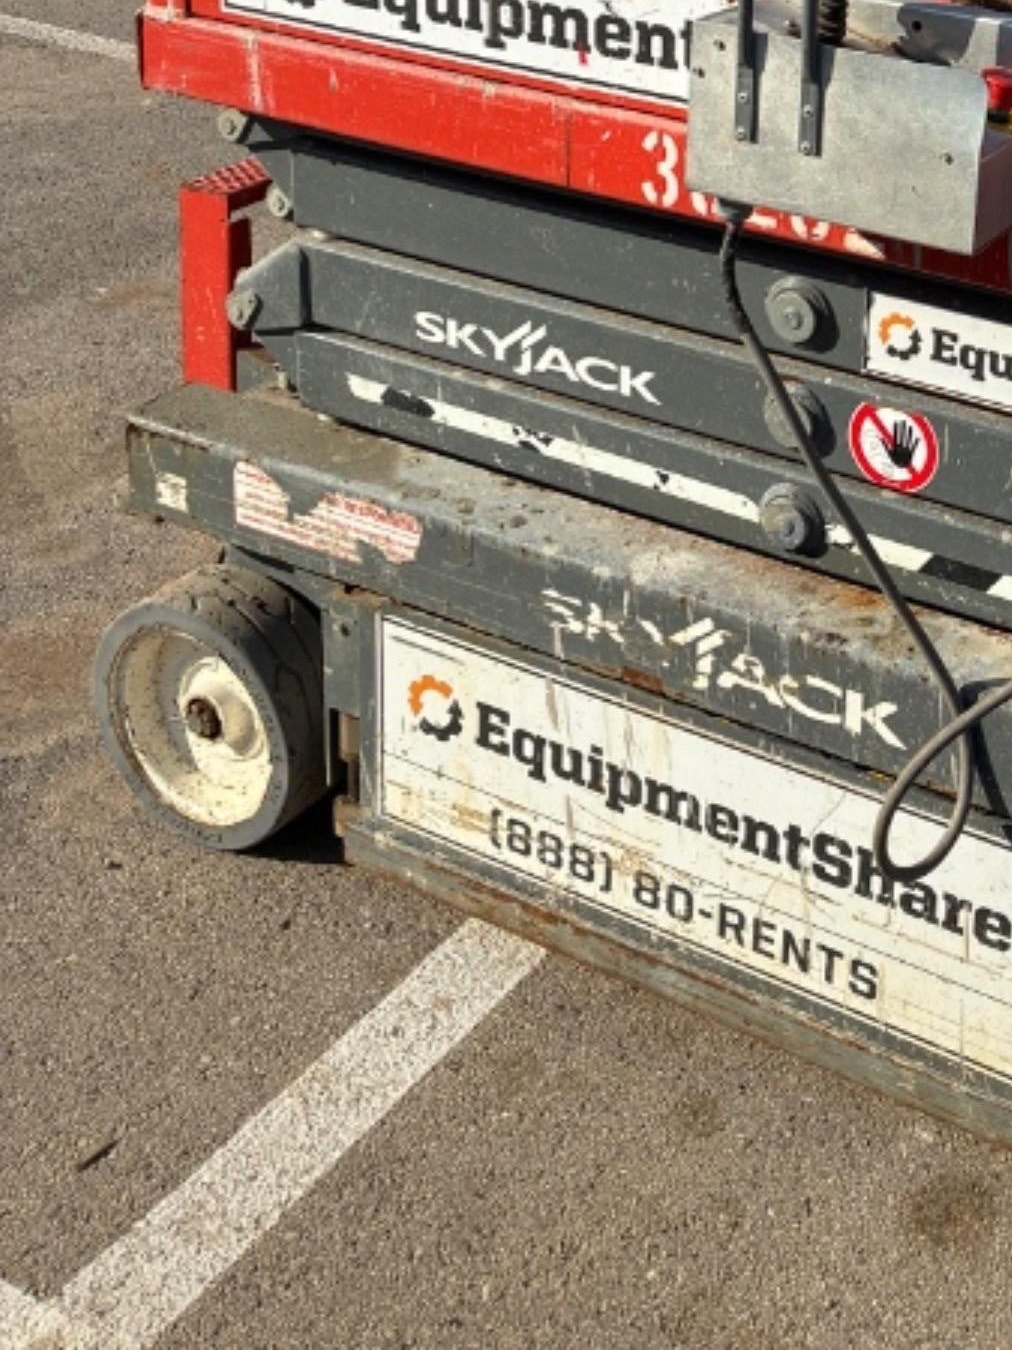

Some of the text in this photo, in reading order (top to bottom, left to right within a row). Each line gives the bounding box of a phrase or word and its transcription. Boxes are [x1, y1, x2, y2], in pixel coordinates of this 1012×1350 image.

[413, 311, 662, 406] SKYJACK
[475, 701, 1012, 952] EquipmentShare
[489, 808, 879, 1000] (888) 80-RENTS
